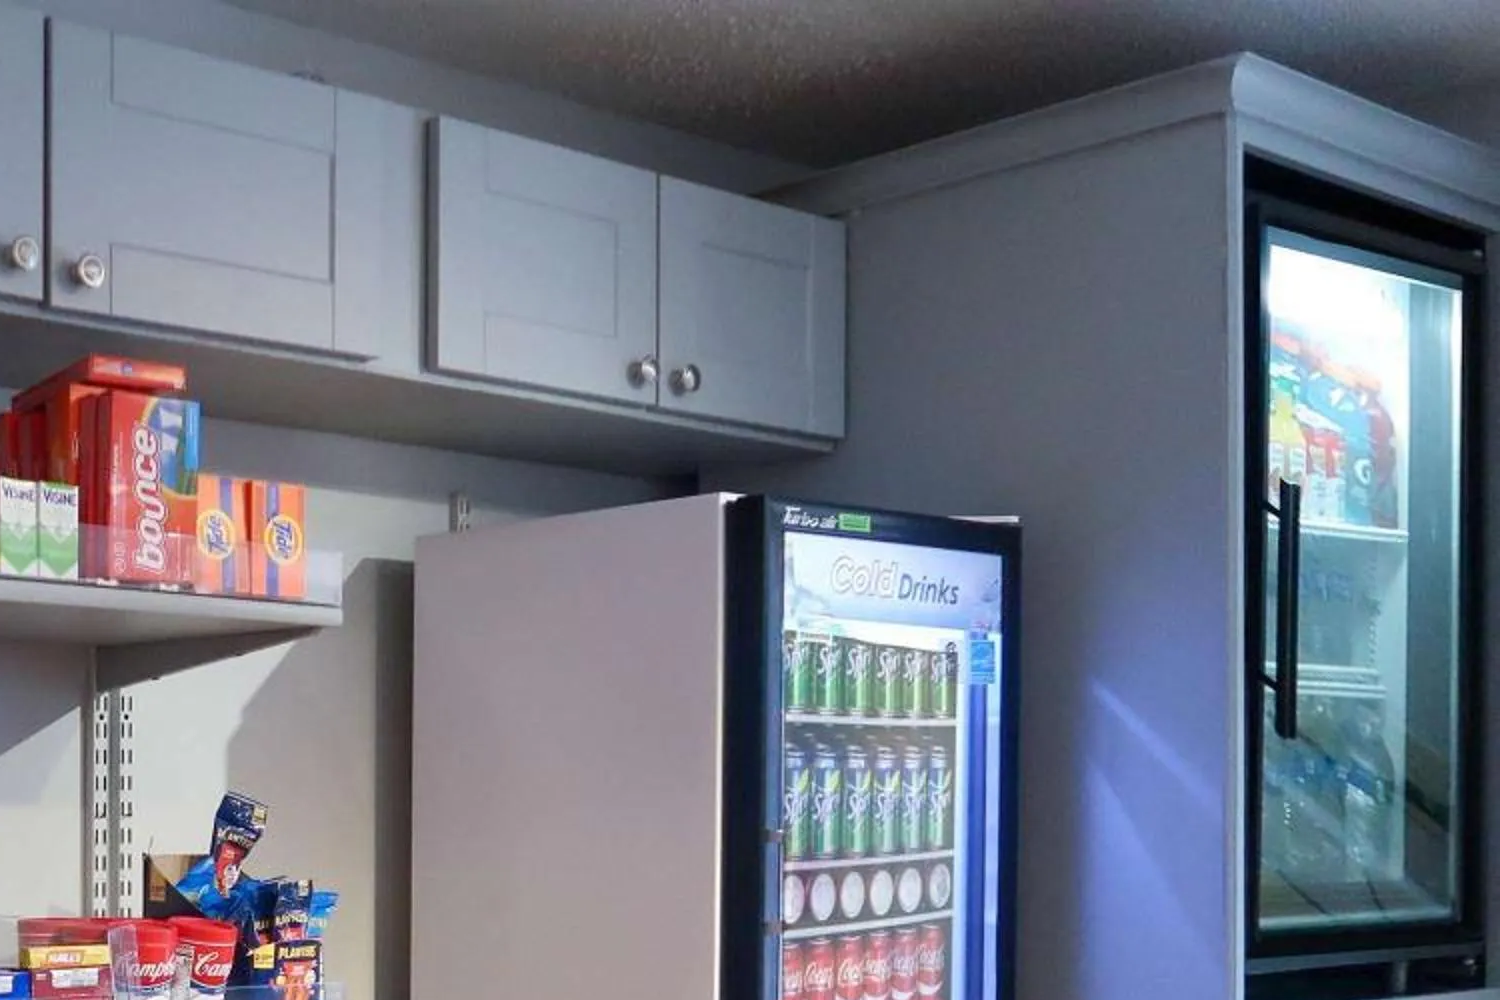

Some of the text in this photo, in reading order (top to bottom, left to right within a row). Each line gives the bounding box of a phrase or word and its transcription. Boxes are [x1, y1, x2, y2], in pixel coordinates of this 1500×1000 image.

[134, 427, 166, 572] bounce
[831, 555, 960, 605] Cold Drinks
